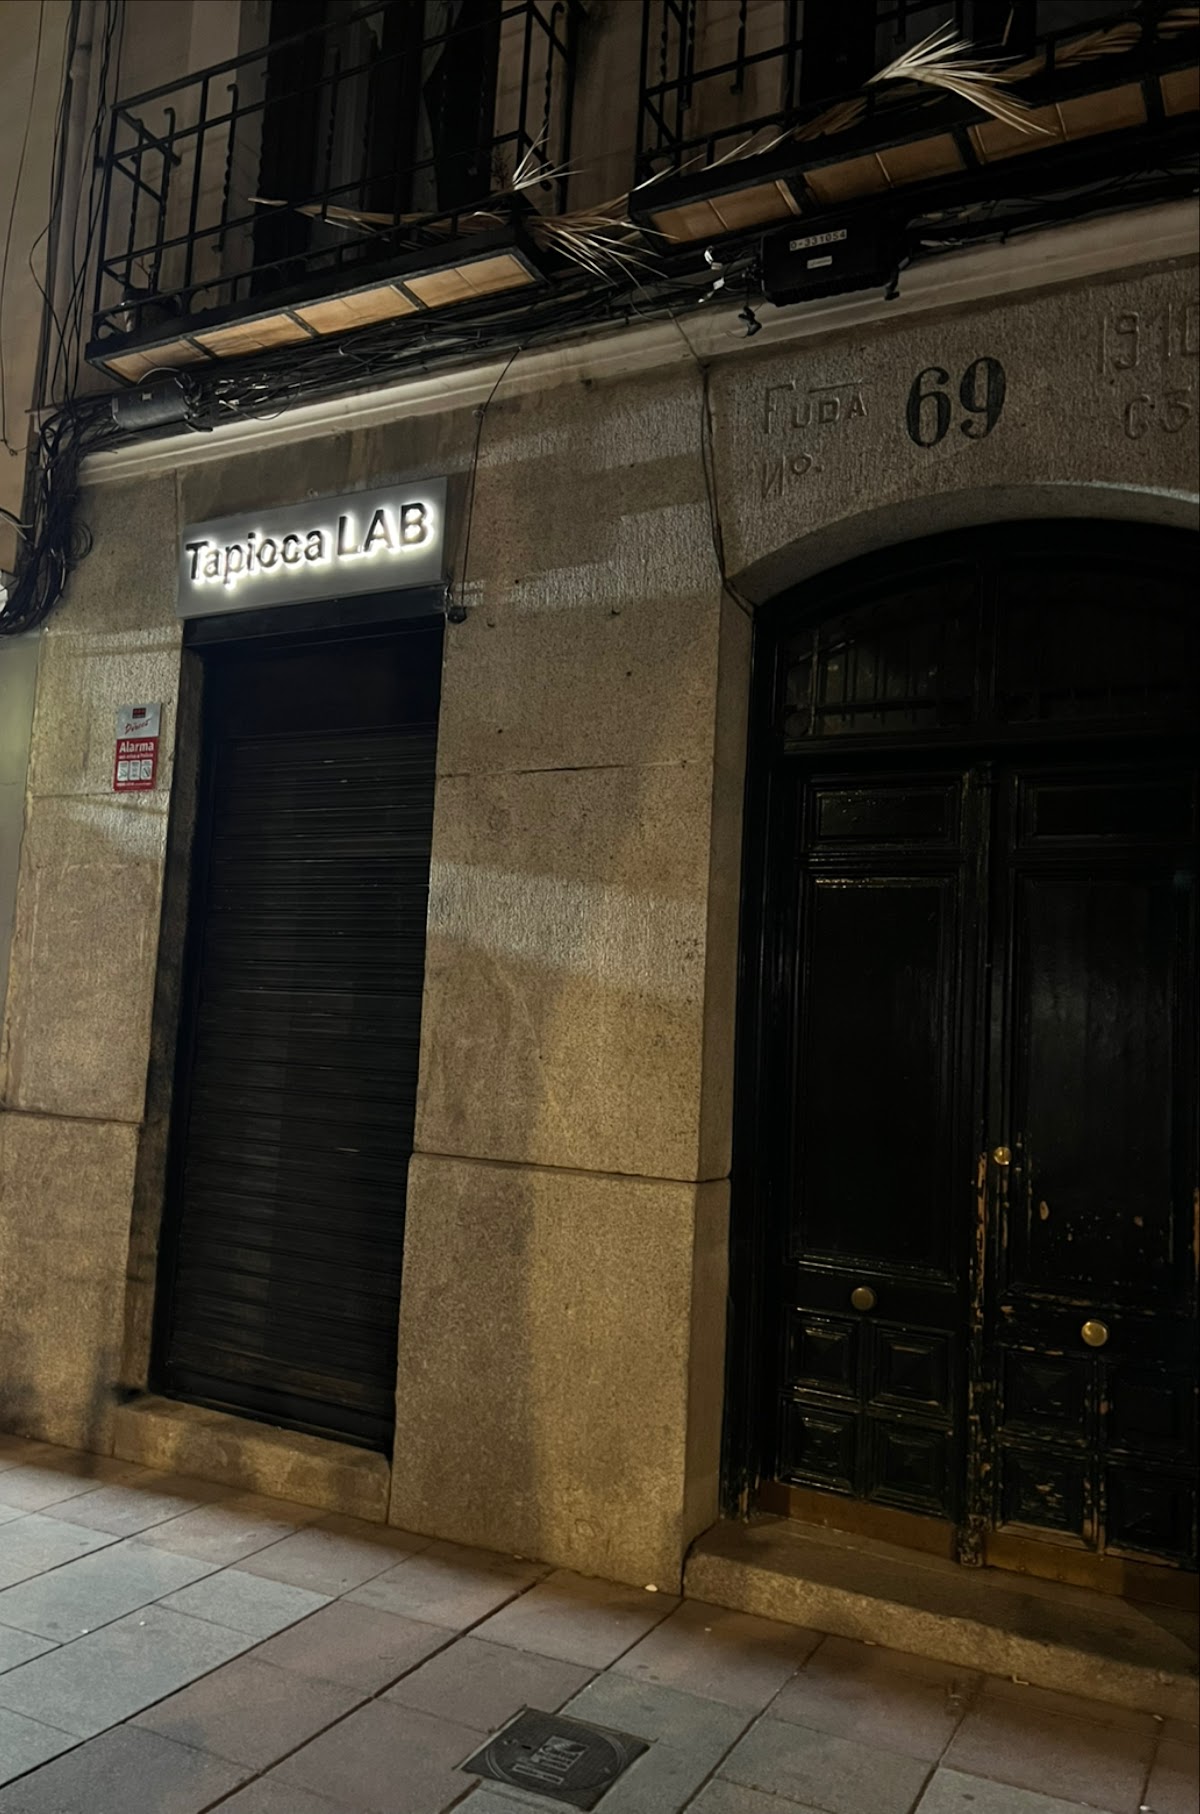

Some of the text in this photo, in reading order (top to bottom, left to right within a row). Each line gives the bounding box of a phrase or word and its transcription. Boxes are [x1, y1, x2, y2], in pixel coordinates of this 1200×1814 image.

[905, 356, 1006, 447] 69
[185, 502, 428, 586] Tapioca LAB
[119, 741, 154, 753] Alarma
